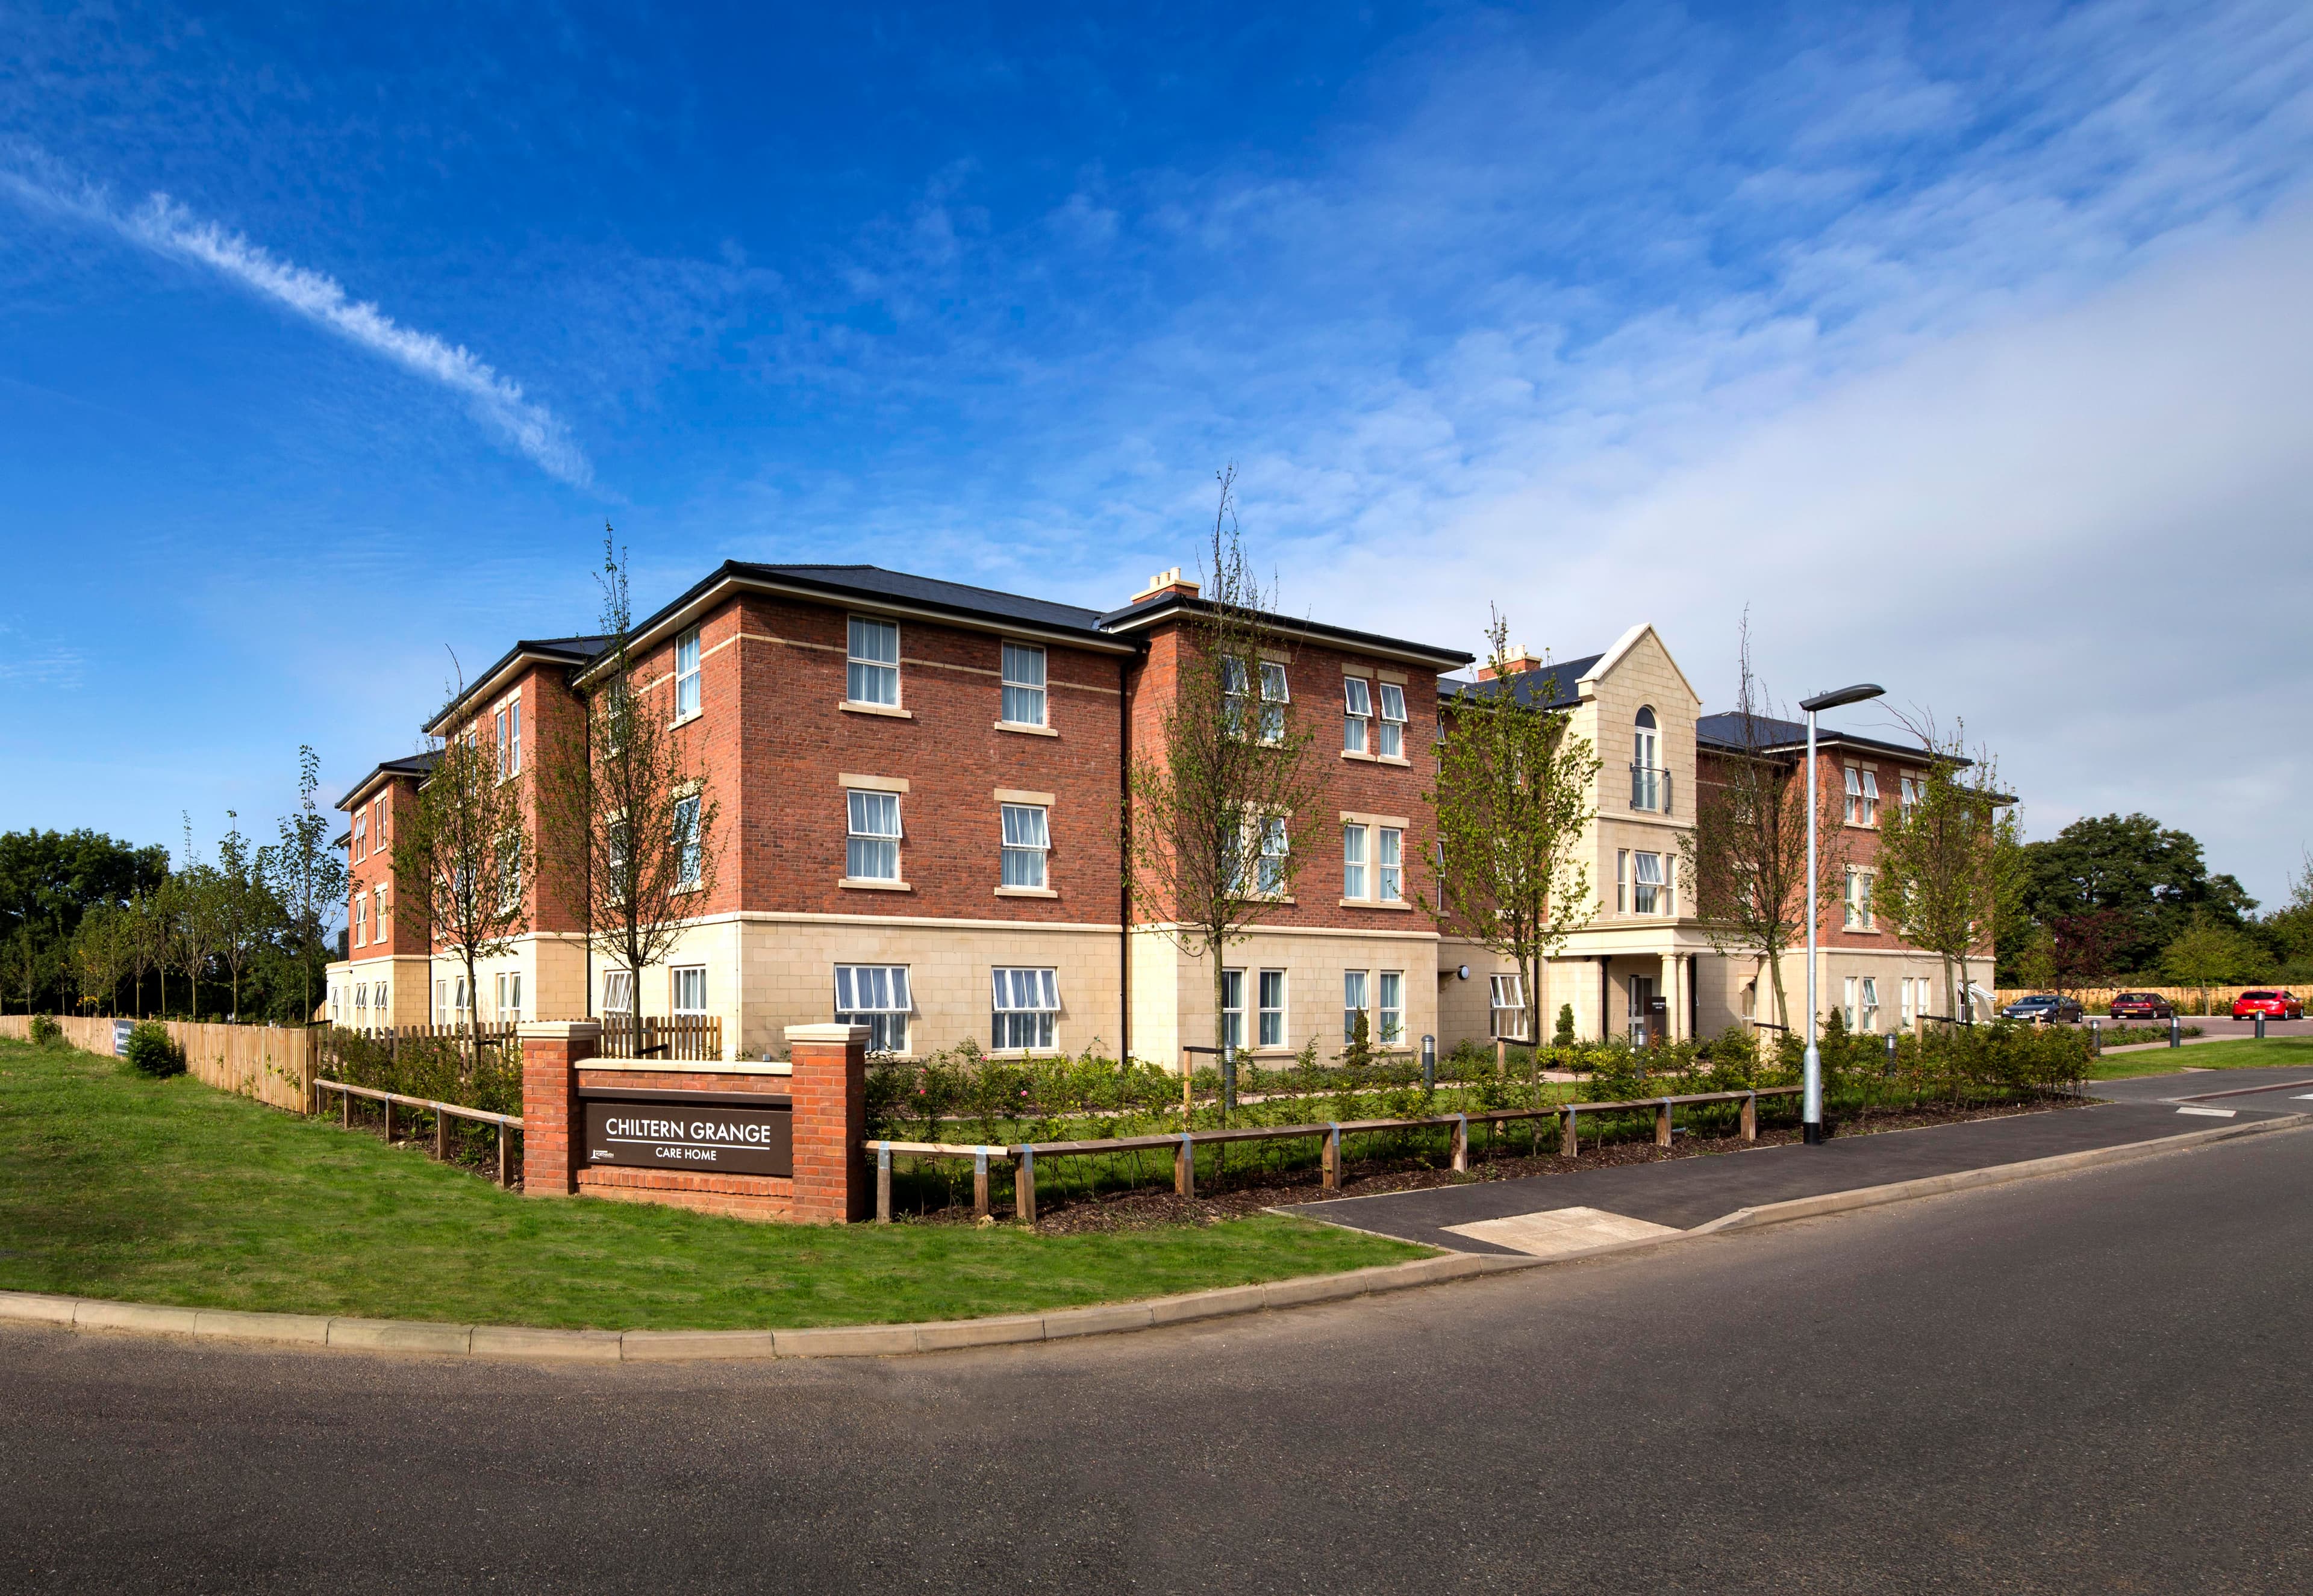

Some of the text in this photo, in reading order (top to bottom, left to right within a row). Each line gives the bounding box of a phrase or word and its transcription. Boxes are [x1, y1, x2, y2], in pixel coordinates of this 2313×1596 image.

[606, 1118, 770, 1143] CHILTERN GRANGE
[655, 1147, 717, 1161] CARE HOME
